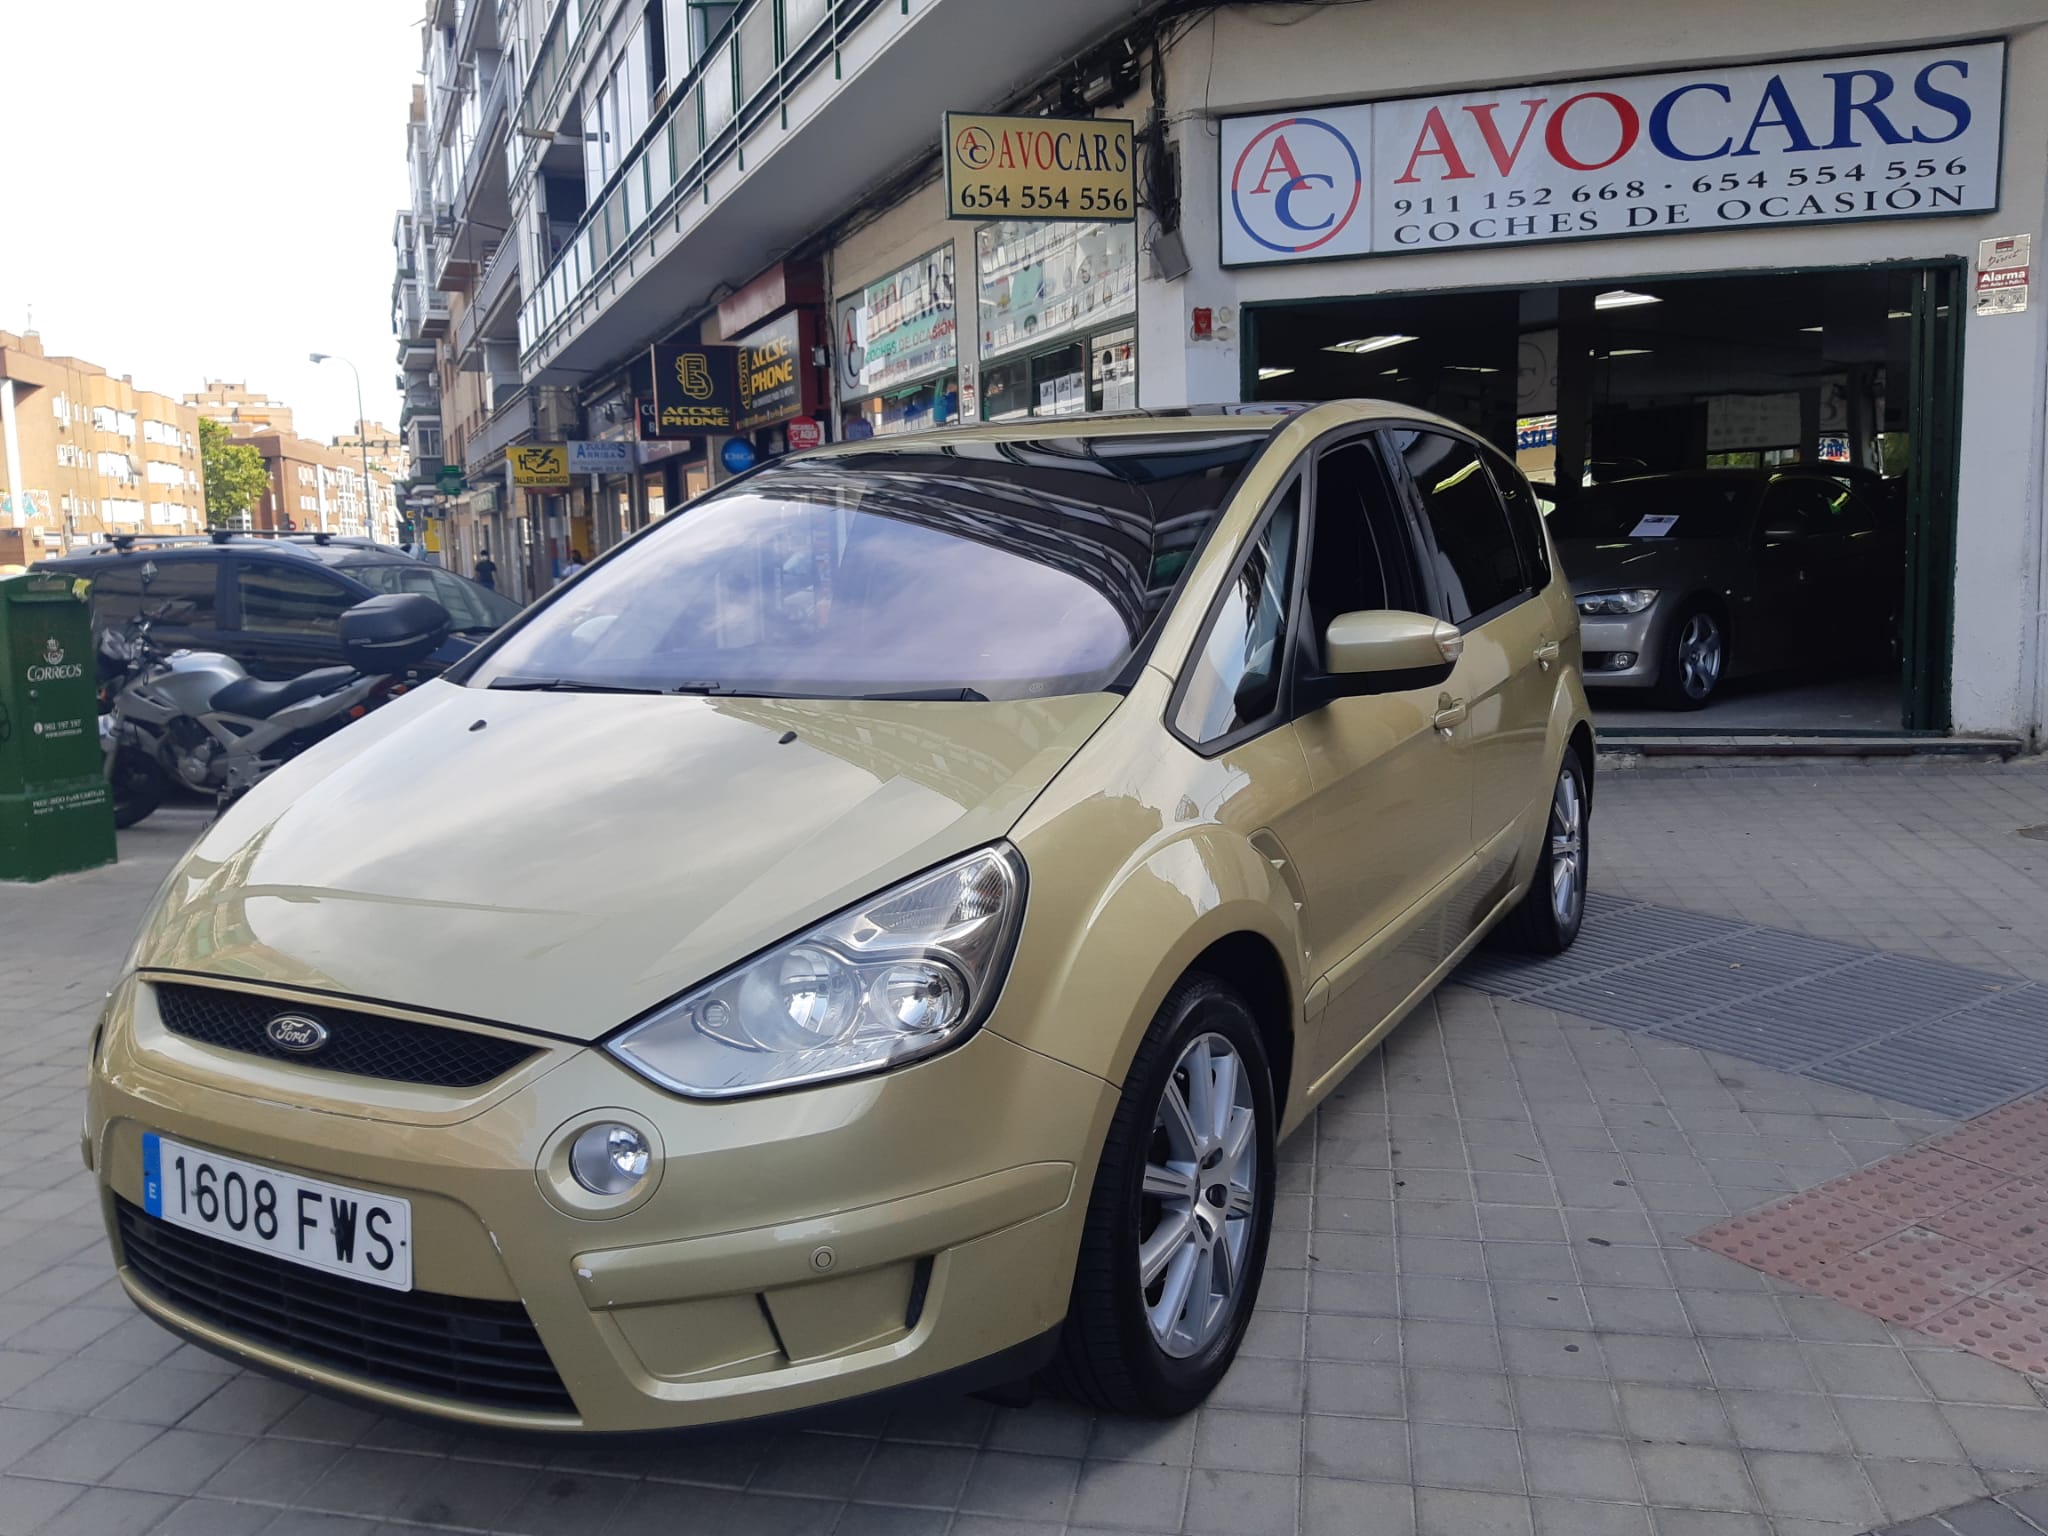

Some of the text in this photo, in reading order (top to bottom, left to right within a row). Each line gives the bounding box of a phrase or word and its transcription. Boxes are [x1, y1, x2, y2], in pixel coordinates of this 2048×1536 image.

[1393, 60, 1972, 185] AVOCARS
[998, 129, 1128, 173] AVOCARS
[960, 184, 1128, 211] 654 554 556
[1393, 156, 1967, 217] 911 152 668 654 554 556
[1393, 182, 1967, 245] COCHES DE OCASIÓN
[1981, 271, 2026, 283] Alarma
[898, 334, 912, 353] DE
[751, 358, 793, 396] PHONE
[661, 416, 731, 427] PHONE
[26, 663, 83, 683] CORREOS
[275, 1020, 311, 1044] Ford
[149, 1181, 158, 1200] E
[174, 1155, 395, 1272] 1608 FWS
